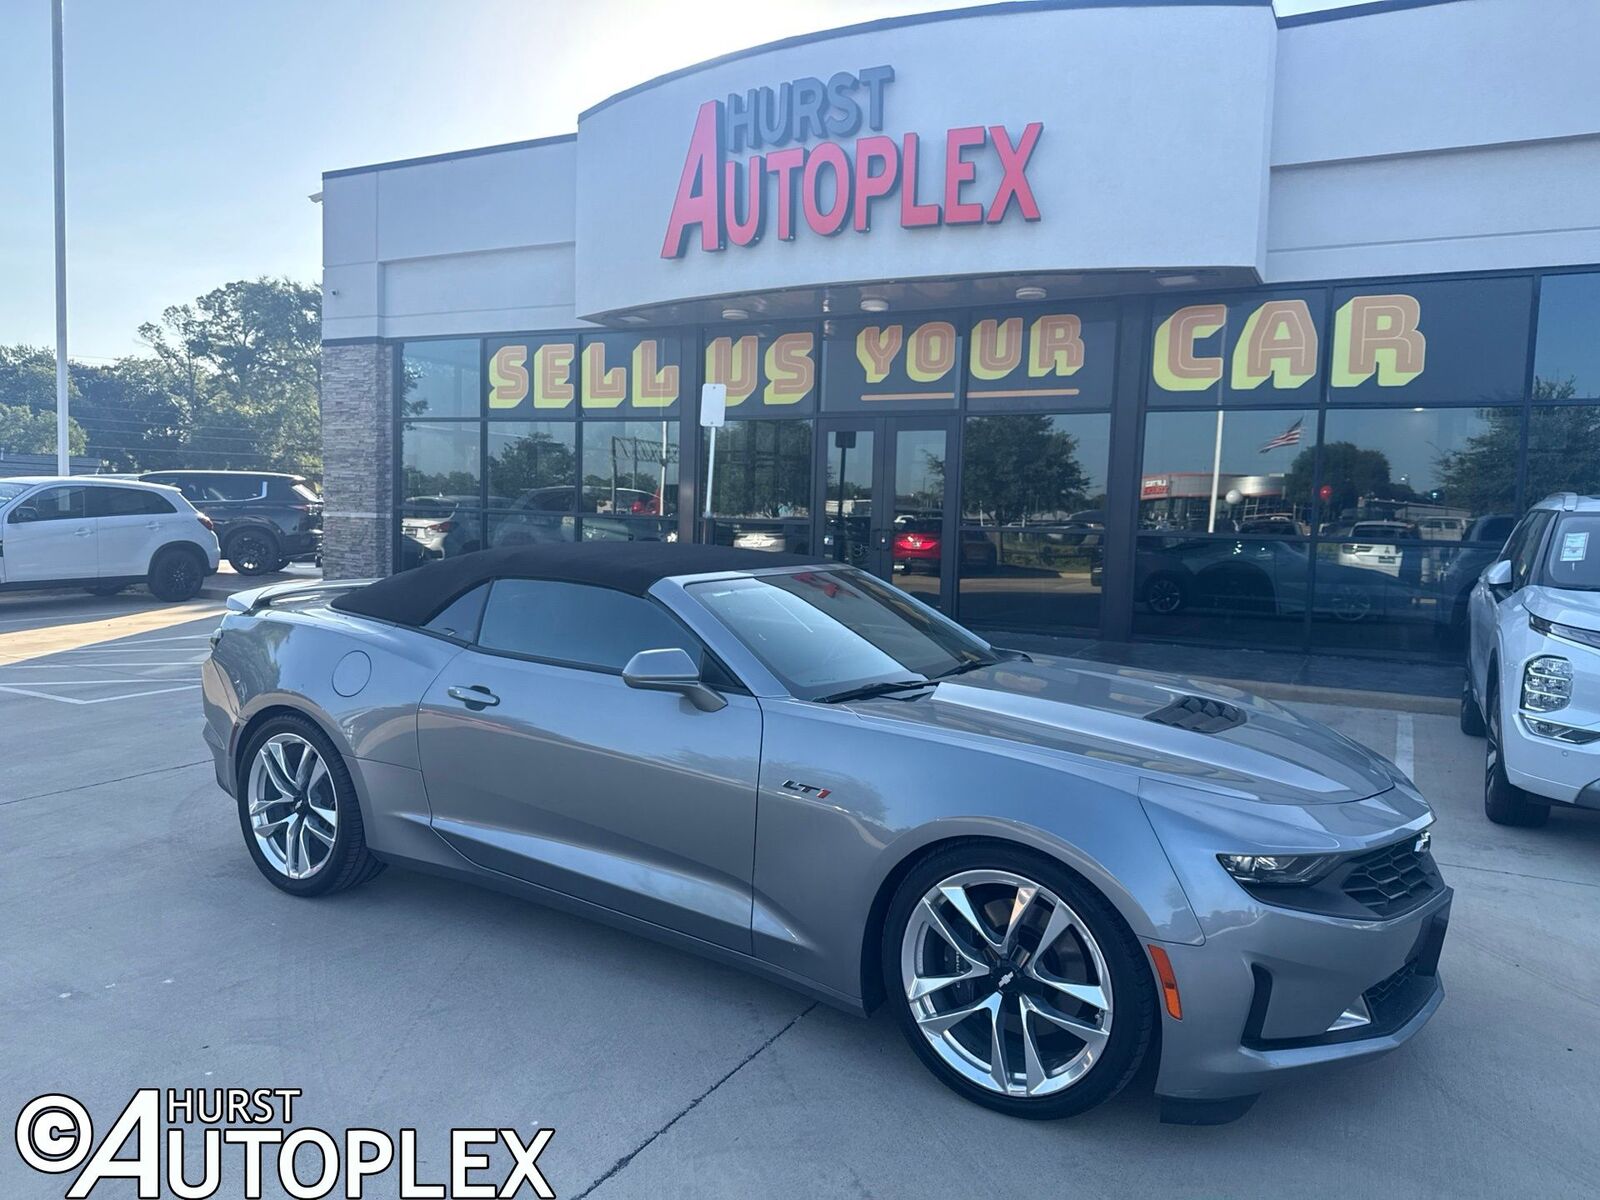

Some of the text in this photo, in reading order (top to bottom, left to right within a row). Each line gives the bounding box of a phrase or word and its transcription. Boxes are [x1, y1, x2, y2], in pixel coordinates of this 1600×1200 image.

[726, 64, 896, 153] HURST
[660, 99, 1044, 260] AUTOPLEX
[488, 294, 1427, 409] SELL US YOUR CAR
[781, 779, 833, 799] LT1
